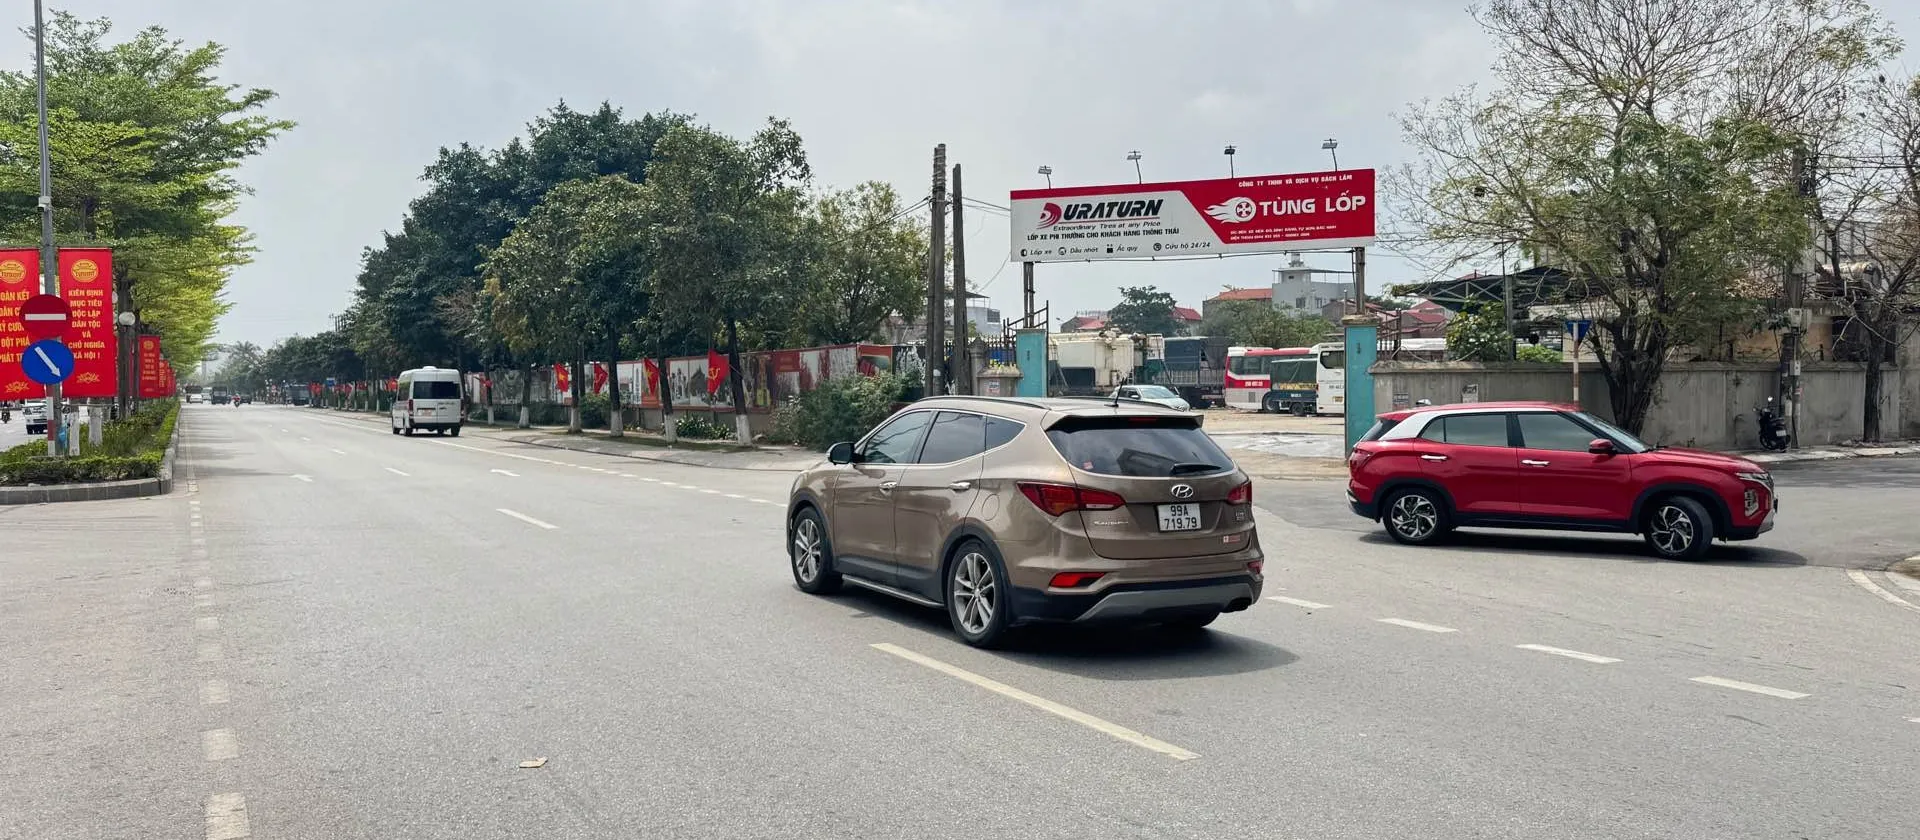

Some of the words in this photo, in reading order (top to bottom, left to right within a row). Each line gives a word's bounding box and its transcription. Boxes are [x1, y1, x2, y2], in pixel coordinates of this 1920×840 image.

[1238, 180, 1254, 188] CÔNG
[1259, 196, 1316, 217] TÙNG
[1325, 189, 1366, 213] LỐP
[1037, 199, 1164, 229] DURATURN
[1053, 224, 1096, 232] Extraordinary
[1128, 221, 1141, 229] any
[1143, 220, 1161, 228] Price
[1100, 229, 1122, 238] KHÁCH
[1190, 243, 1211, 251] 24/24
[16, 289, 30, 301] KẾT
[1, 336, 15, 349] ĐỘT
[16, 335, 31, 347] PHÁ
[84, 350, 96, 360] HỘI
[1170, 504, 1189, 517] 99A
[1164, 516, 1197, 529] 719.79
